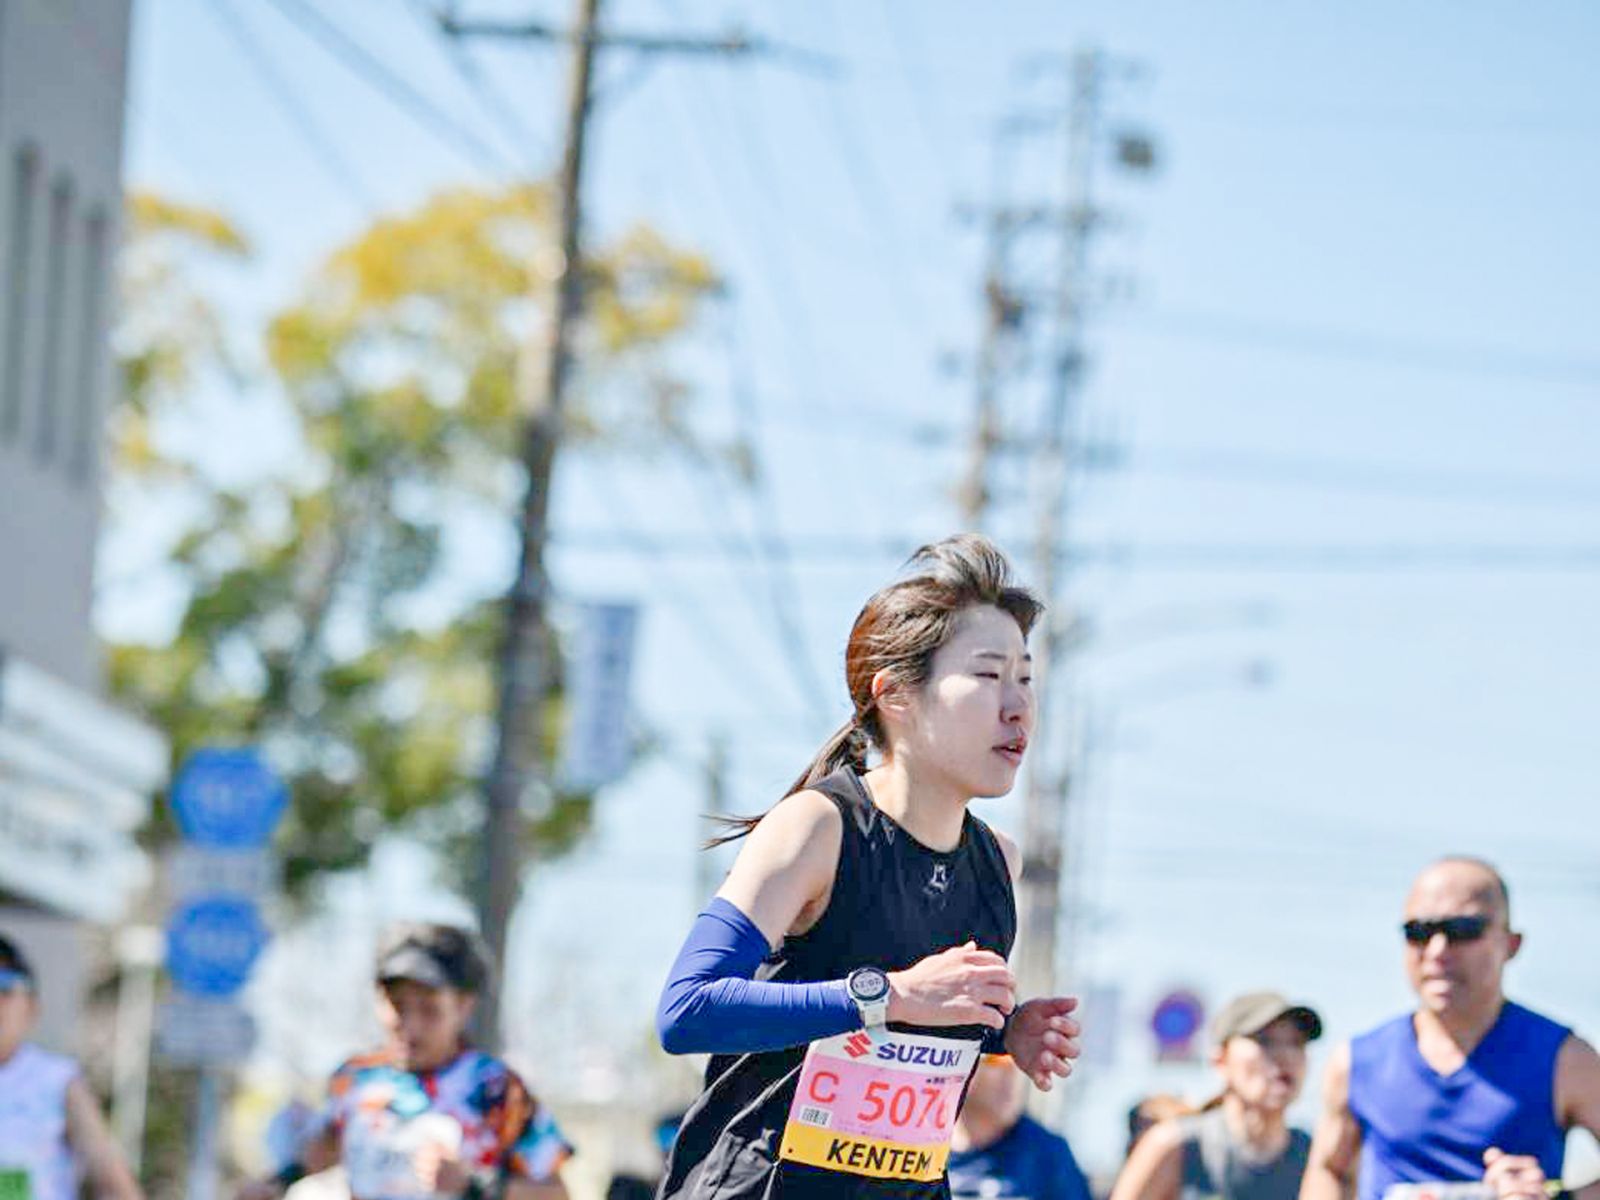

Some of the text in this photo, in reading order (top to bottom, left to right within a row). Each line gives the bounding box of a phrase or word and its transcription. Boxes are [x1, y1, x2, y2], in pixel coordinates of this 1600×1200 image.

[876, 1042, 962, 1067] SUZUKI
[809, 1071, 839, 1103] C
[826, 1138, 933, 1174] KENTEM
